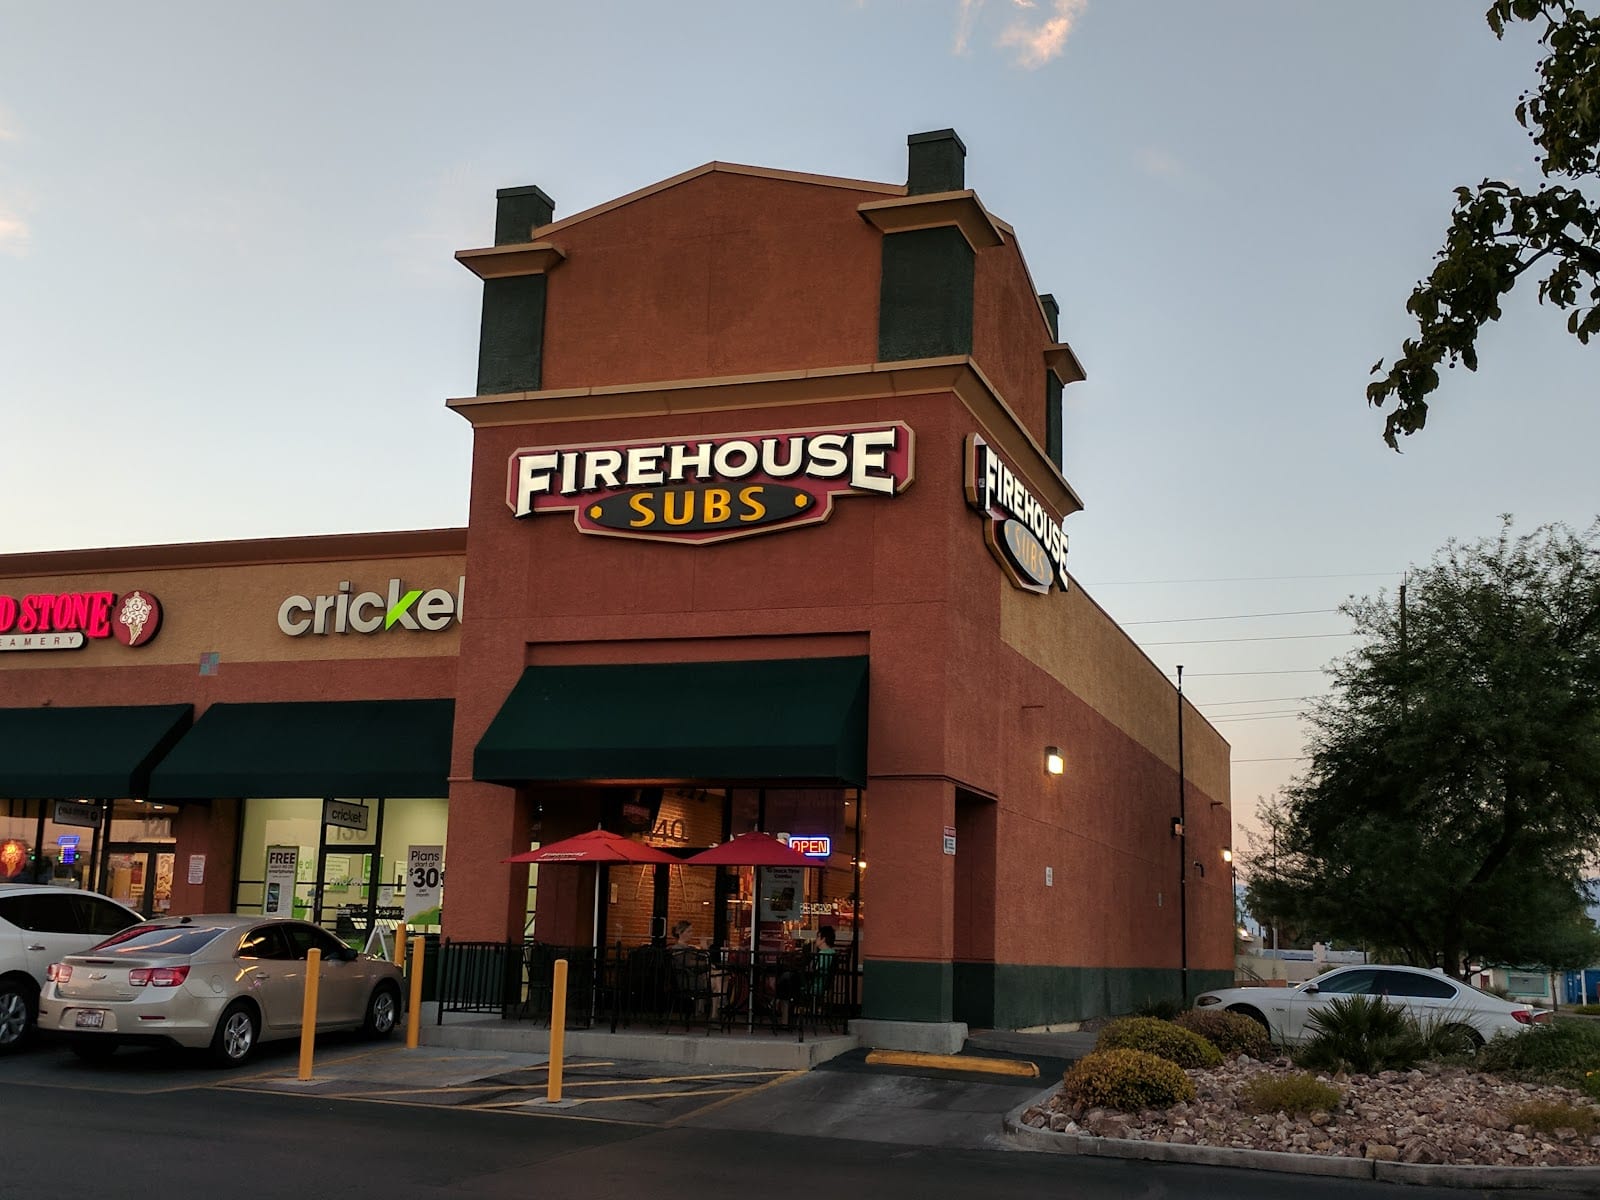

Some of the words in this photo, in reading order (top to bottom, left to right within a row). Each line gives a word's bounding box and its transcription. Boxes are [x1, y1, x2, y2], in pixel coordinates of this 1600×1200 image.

[514, 427, 896, 518] FIREHOUSE
[629, 486, 767, 528] SUBS
[985, 444, 1069, 592] FIREHOUSE
[1014, 525, 1045, 581] SUBS
[18, 590, 114, 638] STONE
[331, 808, 362, 825] cricket
[269, 852, 296, 864] FREE
[411, 850, 440, 862] Plans
[792, 840, 827, 853] OPEN
[409, 867, 439, 888] $30
